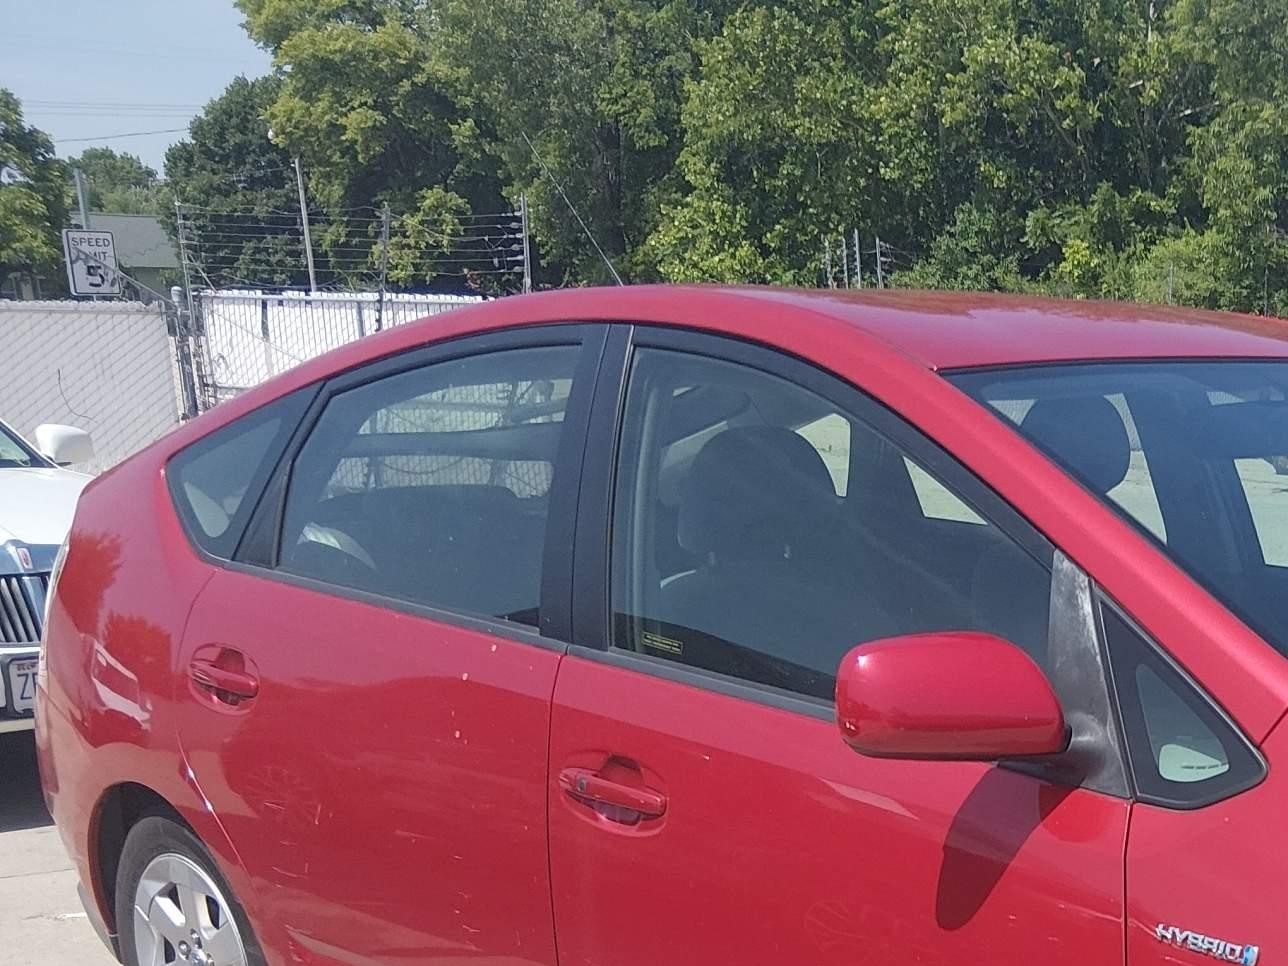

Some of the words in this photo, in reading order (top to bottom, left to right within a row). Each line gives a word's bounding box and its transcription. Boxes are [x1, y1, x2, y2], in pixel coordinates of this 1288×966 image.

[71, 237, 110, 247] SPEED
[87, 265, 105, 287] 5
[1155, 923, 1242, 962] HYBRID
